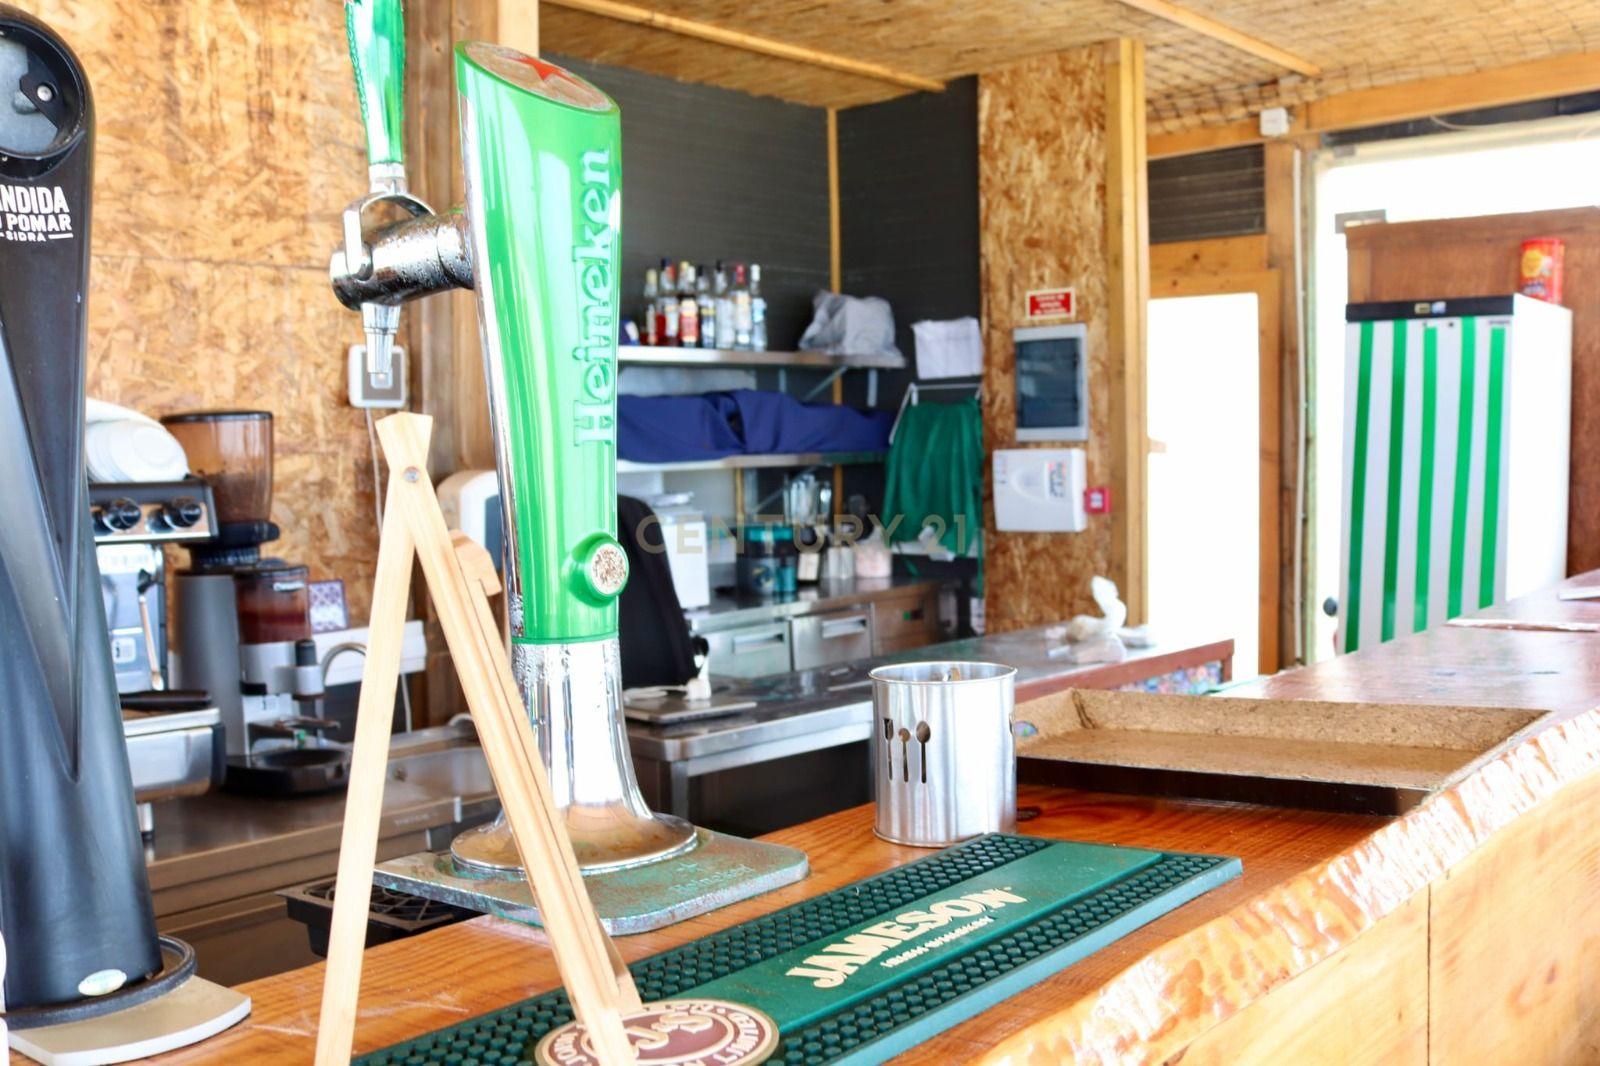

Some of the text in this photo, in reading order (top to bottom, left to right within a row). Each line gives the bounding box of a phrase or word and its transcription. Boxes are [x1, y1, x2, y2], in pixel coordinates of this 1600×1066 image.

[0, 184, 70, 214] NDIDA
[6, 213, 72, 232] POMAR
[6, 230, 46, 242] SIDRA
[572, 147, 615, 447] Heineken
[786, 888, 1027, 988] JAMESON
